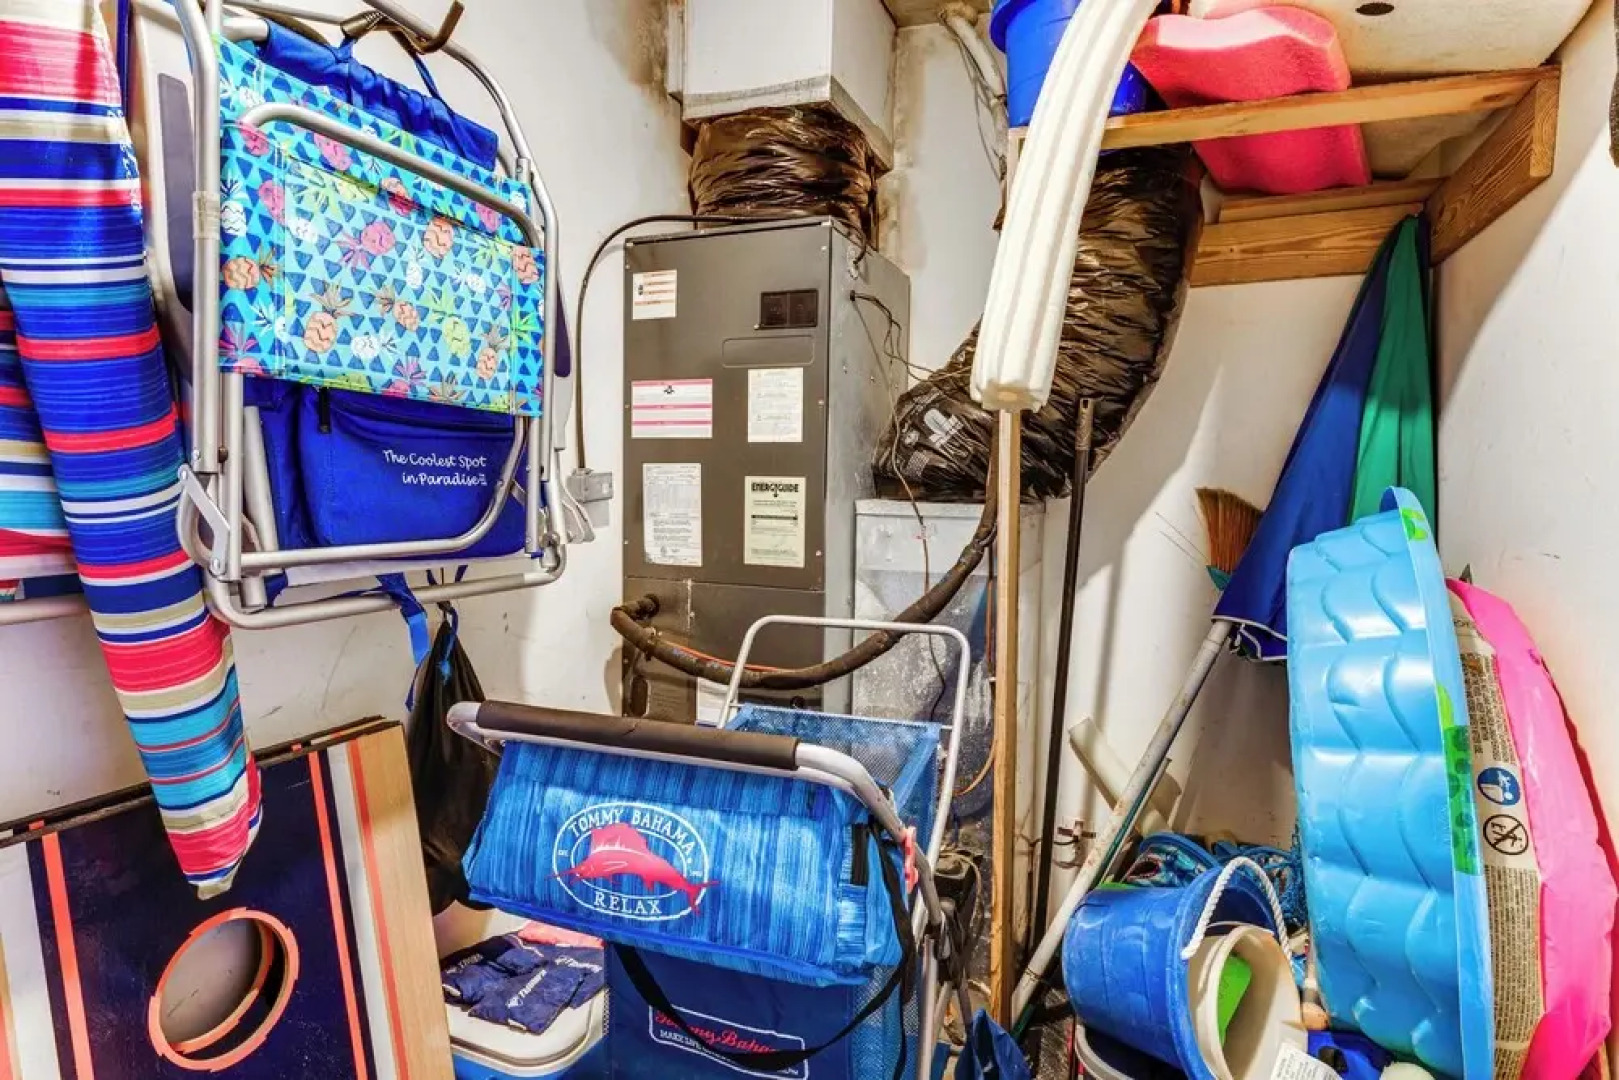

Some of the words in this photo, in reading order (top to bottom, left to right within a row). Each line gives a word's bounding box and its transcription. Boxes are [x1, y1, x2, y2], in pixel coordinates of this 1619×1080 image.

[382, 449, 408, 464] The
[409, 452, 457, 468] Coolest
[402, 472, 418, 485] in
[418, 472, 480, 486] Paradise
[567, 808, 624, 838] TOMMY
[631, 809, 696, 855] BAHAMA
[593, 890, 662, 914] RELAX
